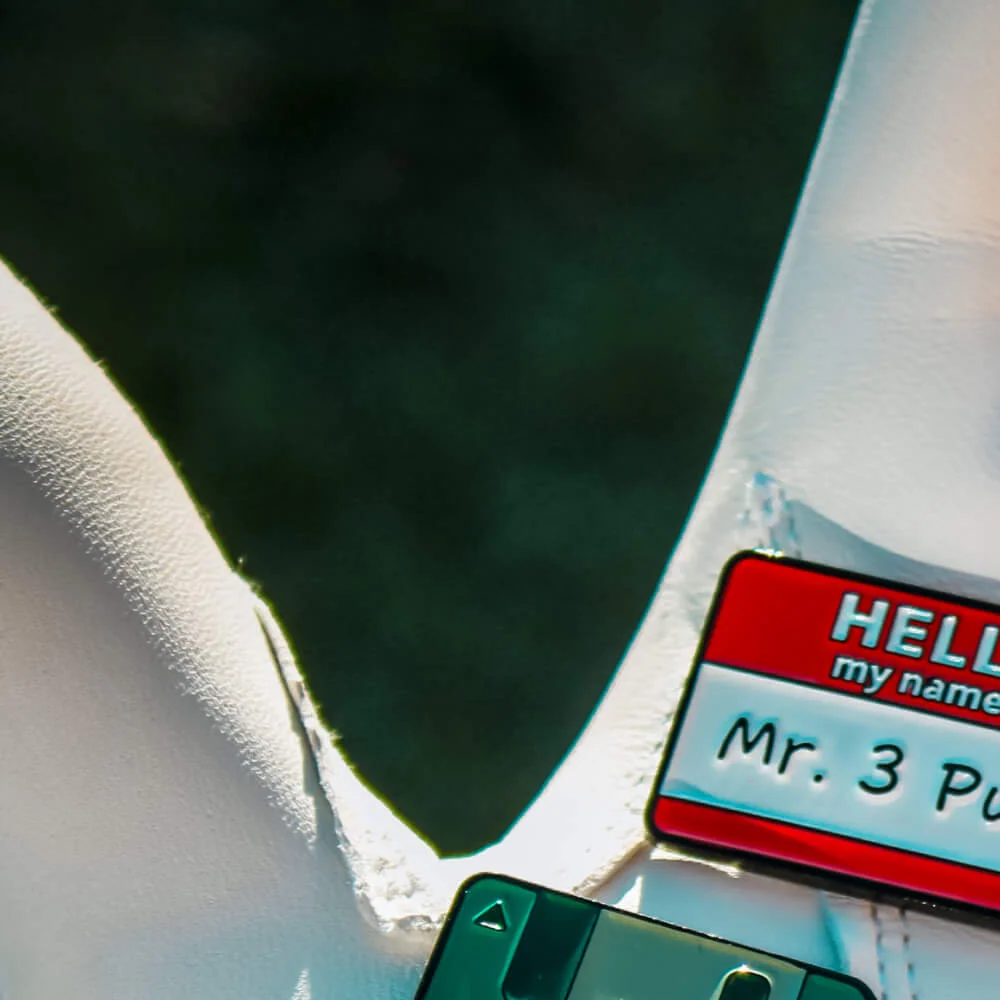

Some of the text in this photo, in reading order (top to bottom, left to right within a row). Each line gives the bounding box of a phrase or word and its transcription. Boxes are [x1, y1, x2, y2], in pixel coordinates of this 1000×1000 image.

[831, 653, 893, 694] my
[717, 716, 825, 784] Mr.
[858, 743, 905, 795] 3
